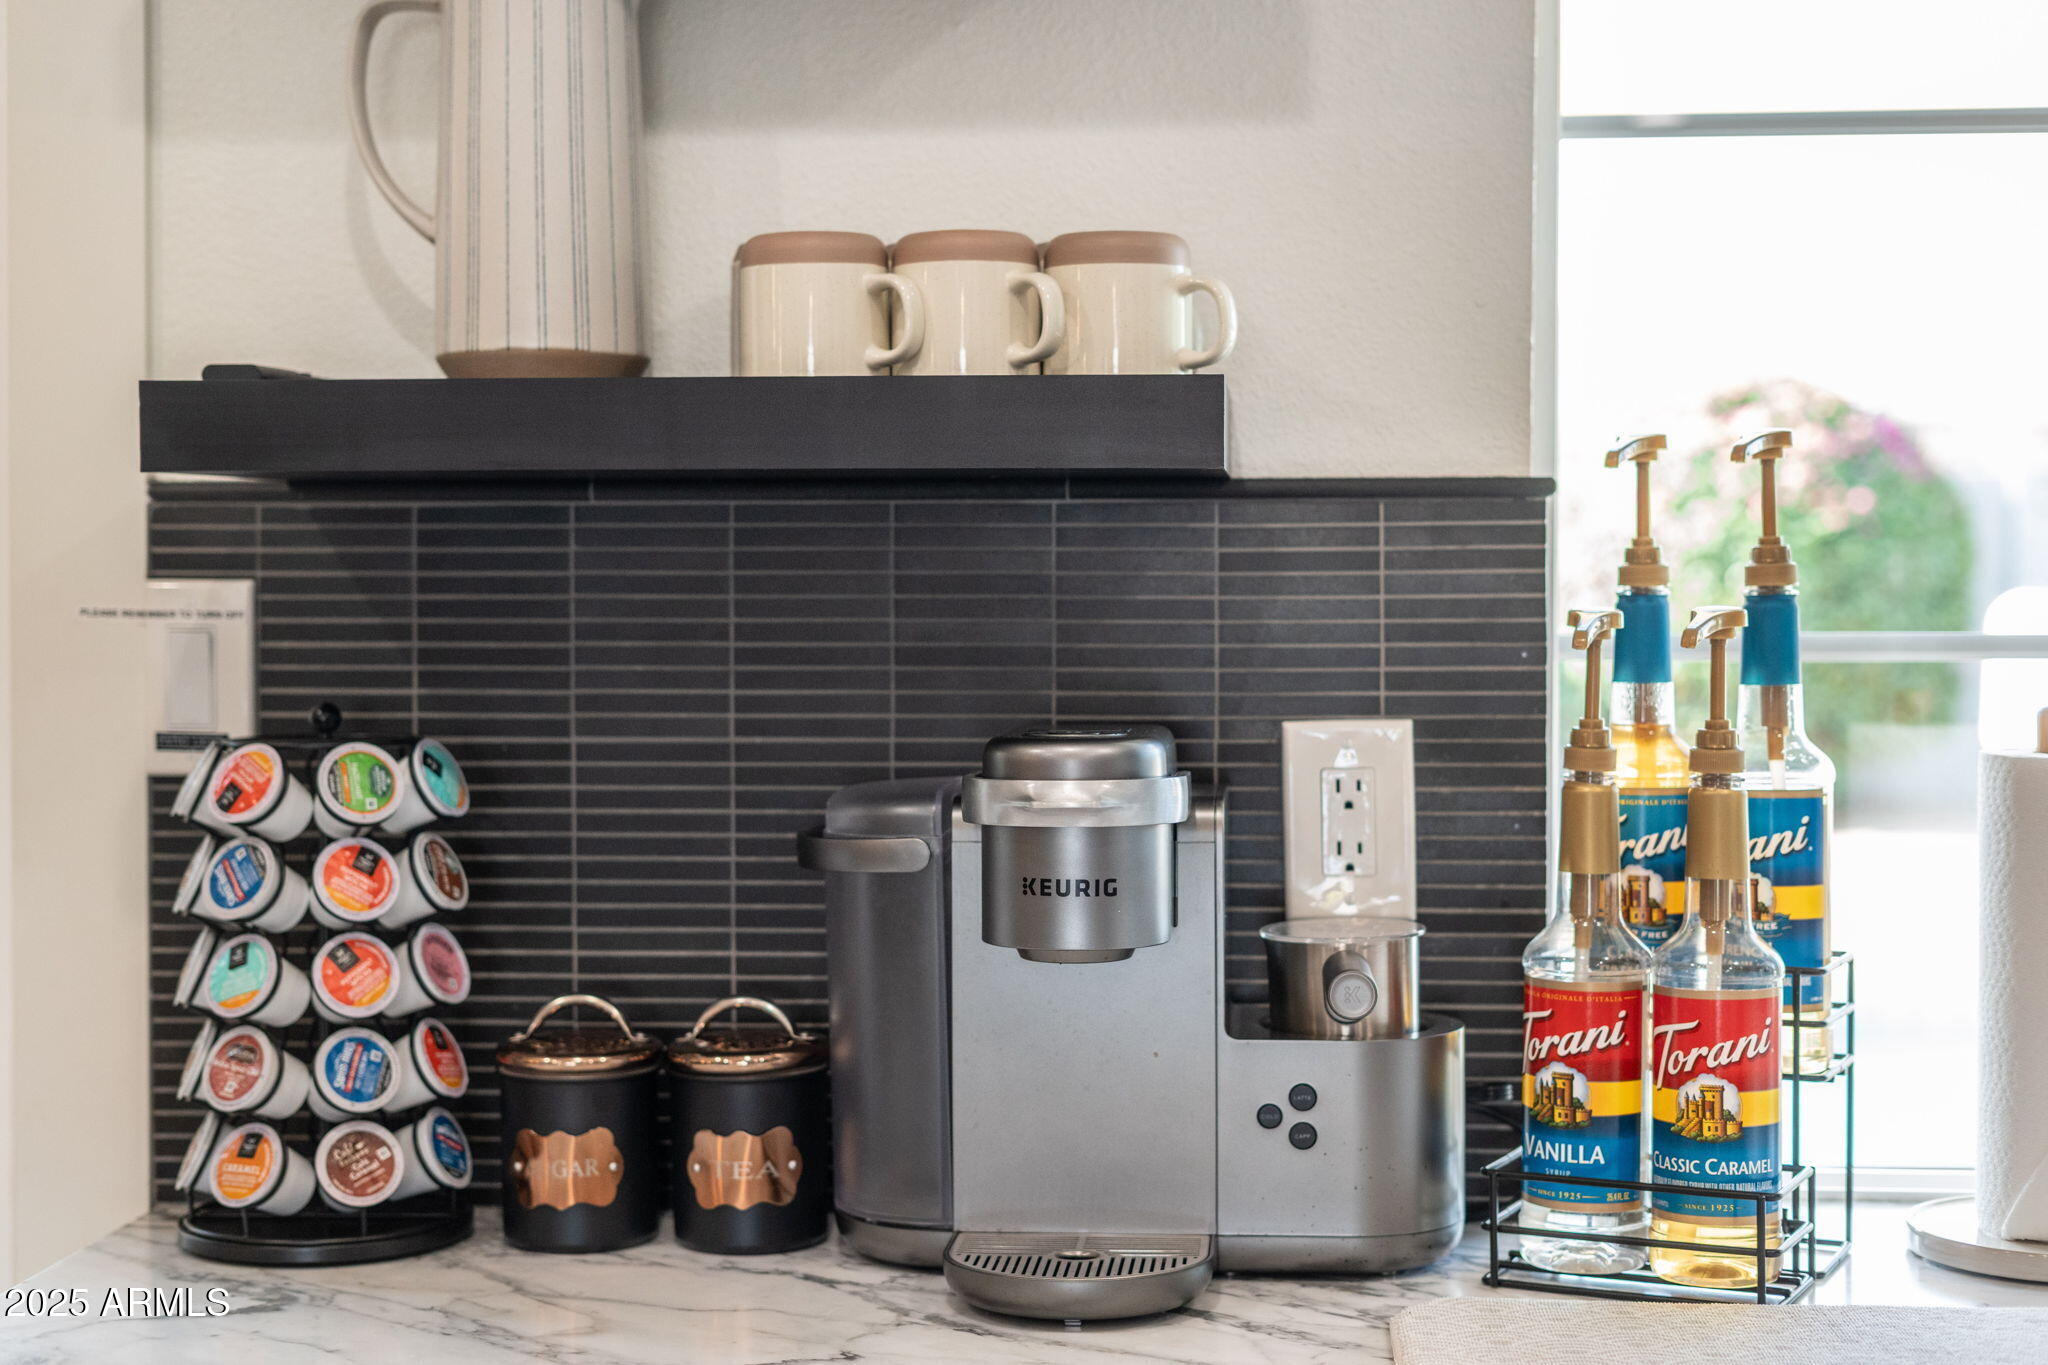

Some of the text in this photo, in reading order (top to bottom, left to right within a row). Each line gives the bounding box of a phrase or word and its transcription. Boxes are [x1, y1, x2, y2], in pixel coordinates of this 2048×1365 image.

[1750, 815, 1809, 861] ani
[1022, 877, 1118, 898] KEURIG
[1523, 1008, 1627, 1075] Torani
[1653, 1017, 1773, 1091] Torani
[1525, 1132, 1606, 1165] VANILLA
[708, 1160, 780, 1180] TEA
[1653, 1150, 1773, 1176] CLASSIC CARAMEL
[1558, 1191, 1582, 1200] 1925
[1710, 1204, 1735, 1212] 1925
